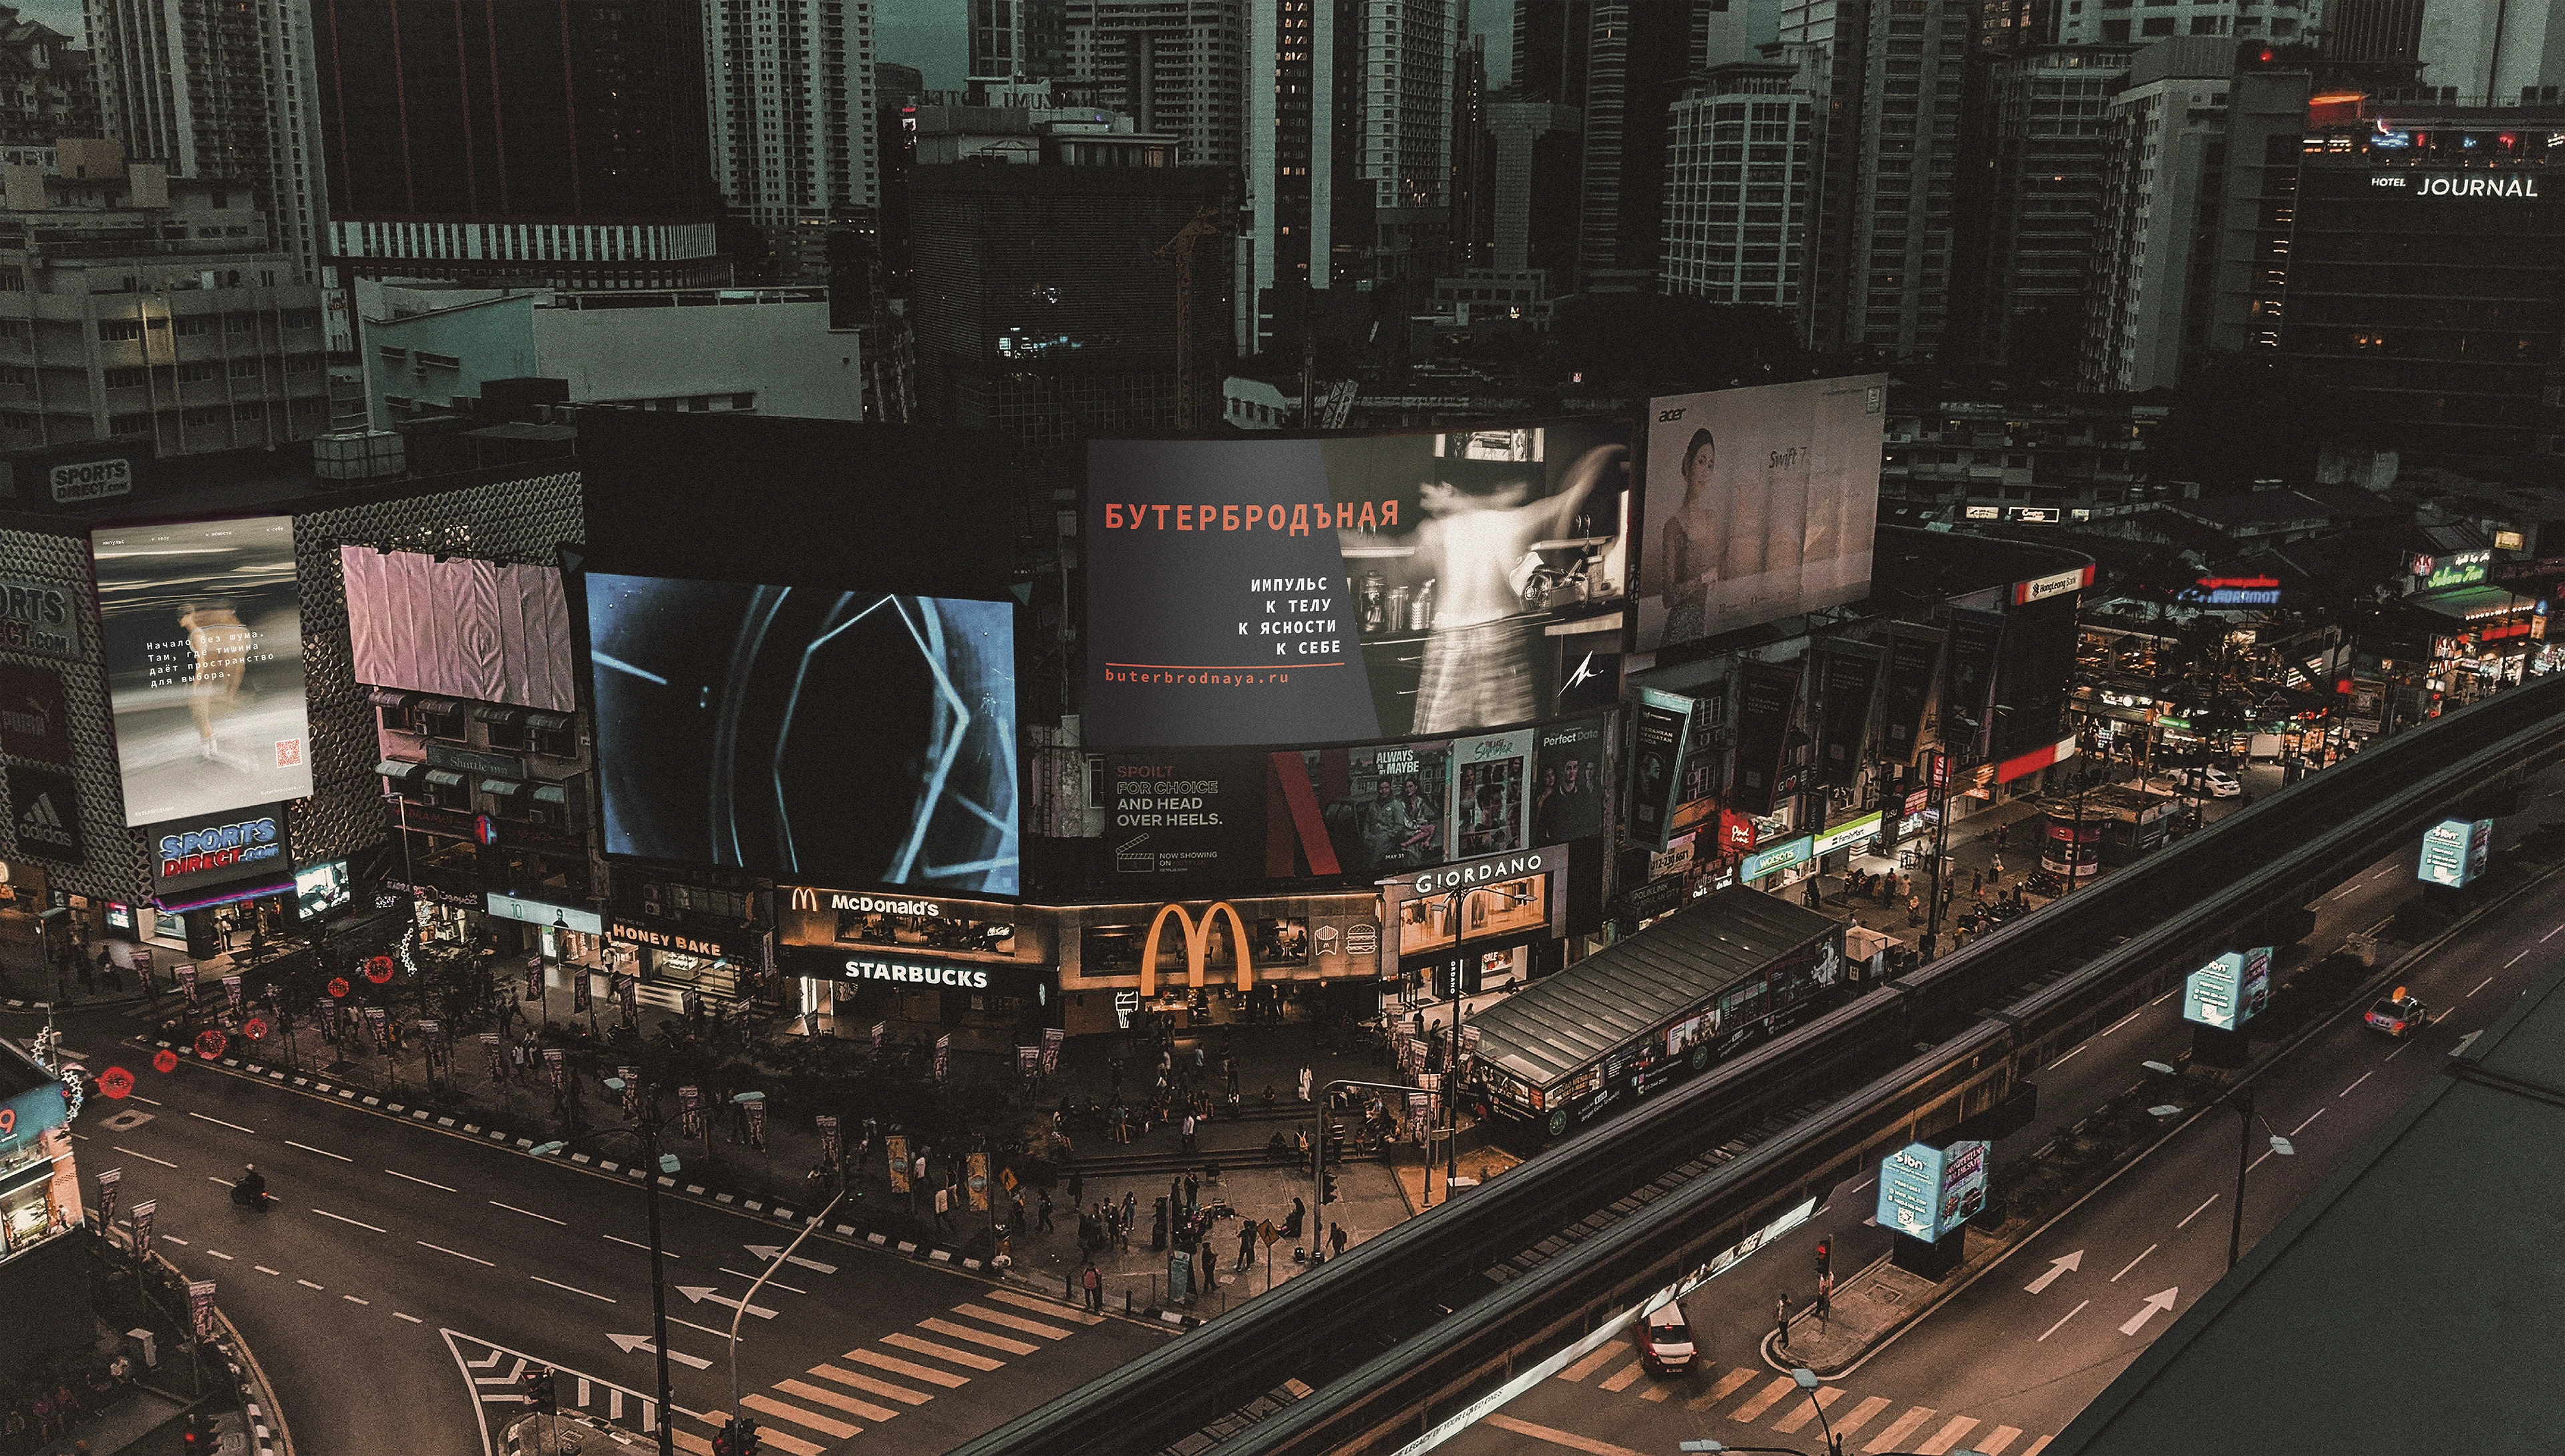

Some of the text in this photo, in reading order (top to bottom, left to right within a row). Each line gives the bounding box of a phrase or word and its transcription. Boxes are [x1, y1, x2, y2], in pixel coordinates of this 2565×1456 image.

[2371, 177, 2538, 197] HOTEL JOURNAL
[1659, 407, 1687, 422] acer
[1769, 447, 1797, 471] Swift
[55, 461, 126, 486] SPORTS
[1105, 500, 1399, 536] БУТЕРБРОДЪНАЯ
[1251, 576, 1328, 592] ИМПУЛЬС
[1266, 598, 1331, 613] К ТЕЛУ
[1238, 619, 1337, 635] К ЯСНОСТИ
[146, 631, 263, 651] Начало без шума.
[1276, 640, 1341, 655] К СЕБЕ
[148, 643, 259, 663] Там, где тишина
[149, 653, 274, 676] даёт пространство
[150, 671, 230, 689] для выбора.
[1105, 668, 1289, 687] buterbrodnaya.ru
[1543, 733, 1576, 747] Perfect
[1376, 749, 1413, 764] ALWAYS
[1117, 765, 1174, 778] SPOILT
[1387, 761, 1419, 775] MAYBE
[1117, 780, 1218, 795] FOR CHOICE
[1117, 797, 1203, 810] AND HEAD
[1117, 813, 1223, 826] OVER HEELS.
[19, 824, 72, 846] adidas
[159, 817, 277, 860] SPORTS
[1838, 828, 1864, 844] FamilyMart
[1759, 850, 1795, 868] watsons
[831, 894, 939, 917] McDonald's
[613, 923, 721, 957] HONEY BAKE
[1483, 951, 1499, 963] SALE
[846, 960, 988, 988] STARBUCKS
[1404, 1432, 1433, 1455] LEGACY
[1432, 1427, 1443, 1438] OF
[1443, 1415, 1462, 1431] YOUR
[1462, 1401, 1484, 1419] LOVED
